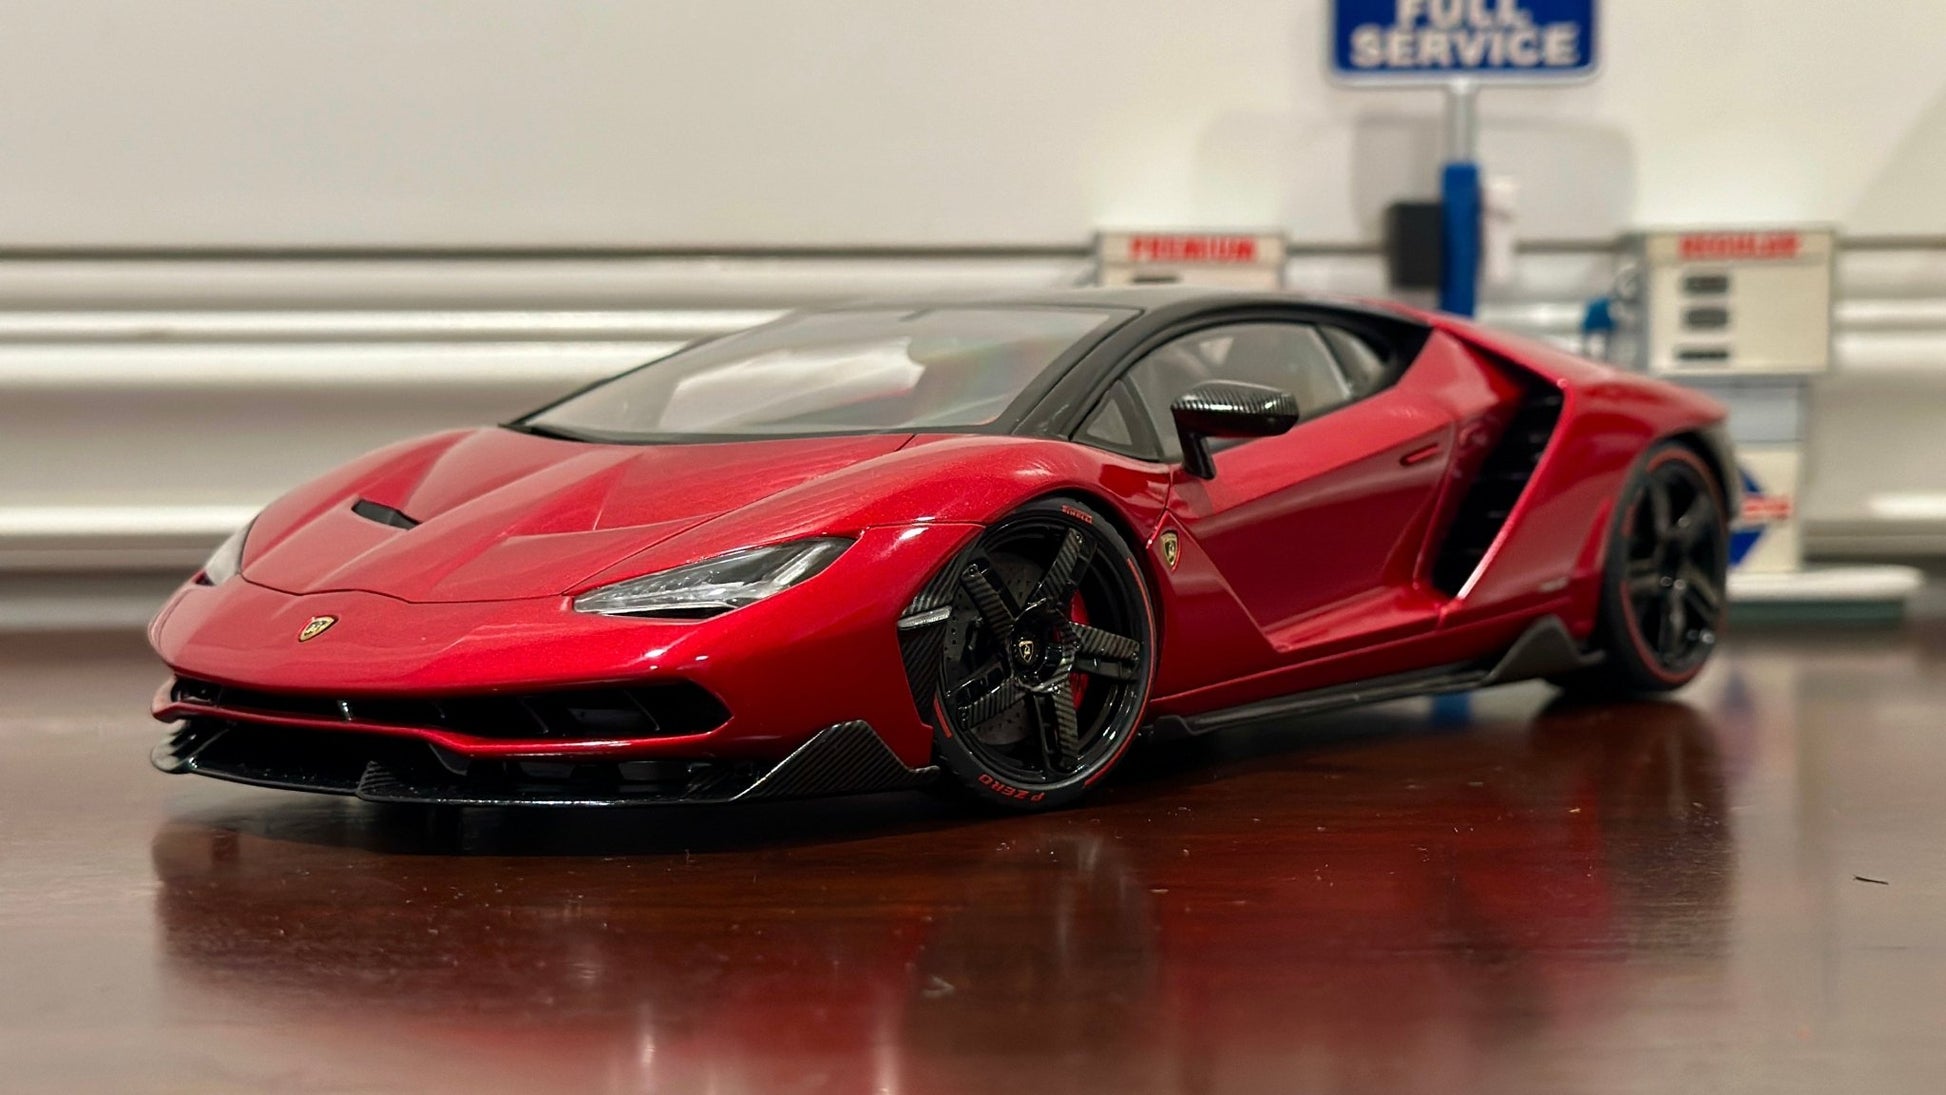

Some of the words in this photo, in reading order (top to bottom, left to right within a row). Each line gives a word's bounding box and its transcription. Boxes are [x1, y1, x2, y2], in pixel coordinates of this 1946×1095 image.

[1395, 0, 1532, 29] FULL
[1350, 22, 1580, 67] SERVICE
[1129, 235, 1257, 262] PREMIUM
[978, 773, 1029, 800] ZERO
